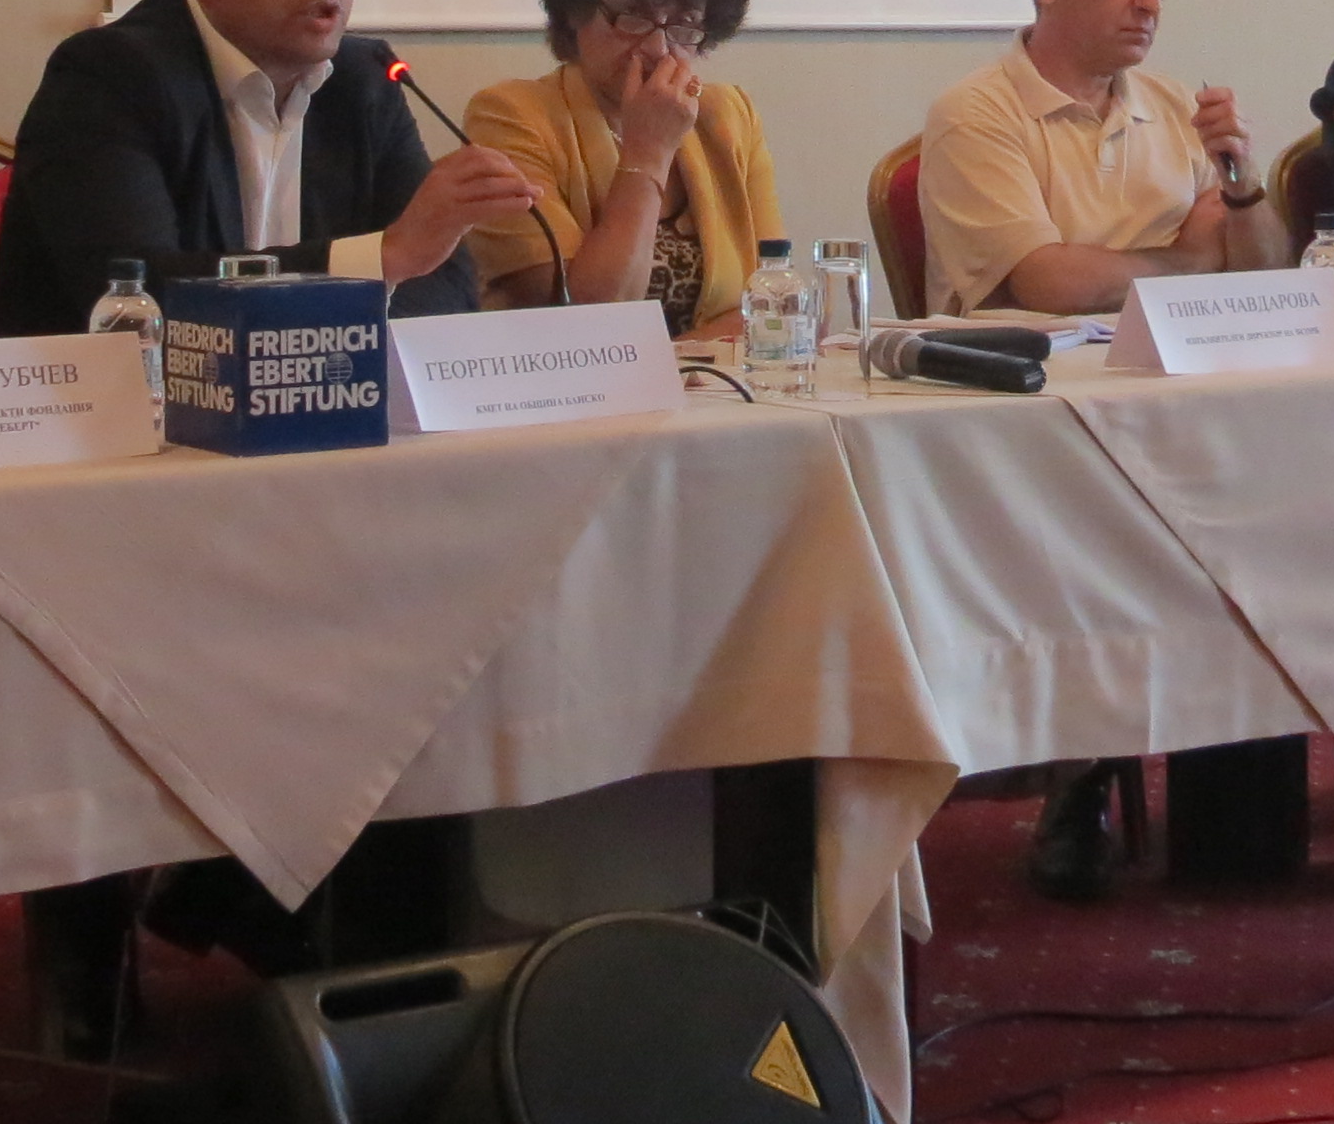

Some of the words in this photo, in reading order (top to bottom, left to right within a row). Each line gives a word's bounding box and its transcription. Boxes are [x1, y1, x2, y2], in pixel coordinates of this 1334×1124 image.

[1167, 298, 1222, 318] ГИНКА
[1224, 291, 1321, 314] ЧАВДАРОВА
[168, 319, 234, 355] FRIEDRICH
[248, 324, 379, 357] FRIEDRICH
[168, 348, 205, 378] EBERT
[249, 356, 327, 387] EBERT
[425, 358, 507, 382] ГЕОРГИ
[511, 344, 639, 374] ИКОНОМОВ
[168, 377, 235, 413] STIFTUNG
[249, 381, 380, 417] STIFTUNG
[475, 402, 503, 414] КМЕТ
[504, 401, 519, 412] НА
[519, 398, 563, 411] ОБЩИНА
[565, 393, 606, 406] БАНСКО
